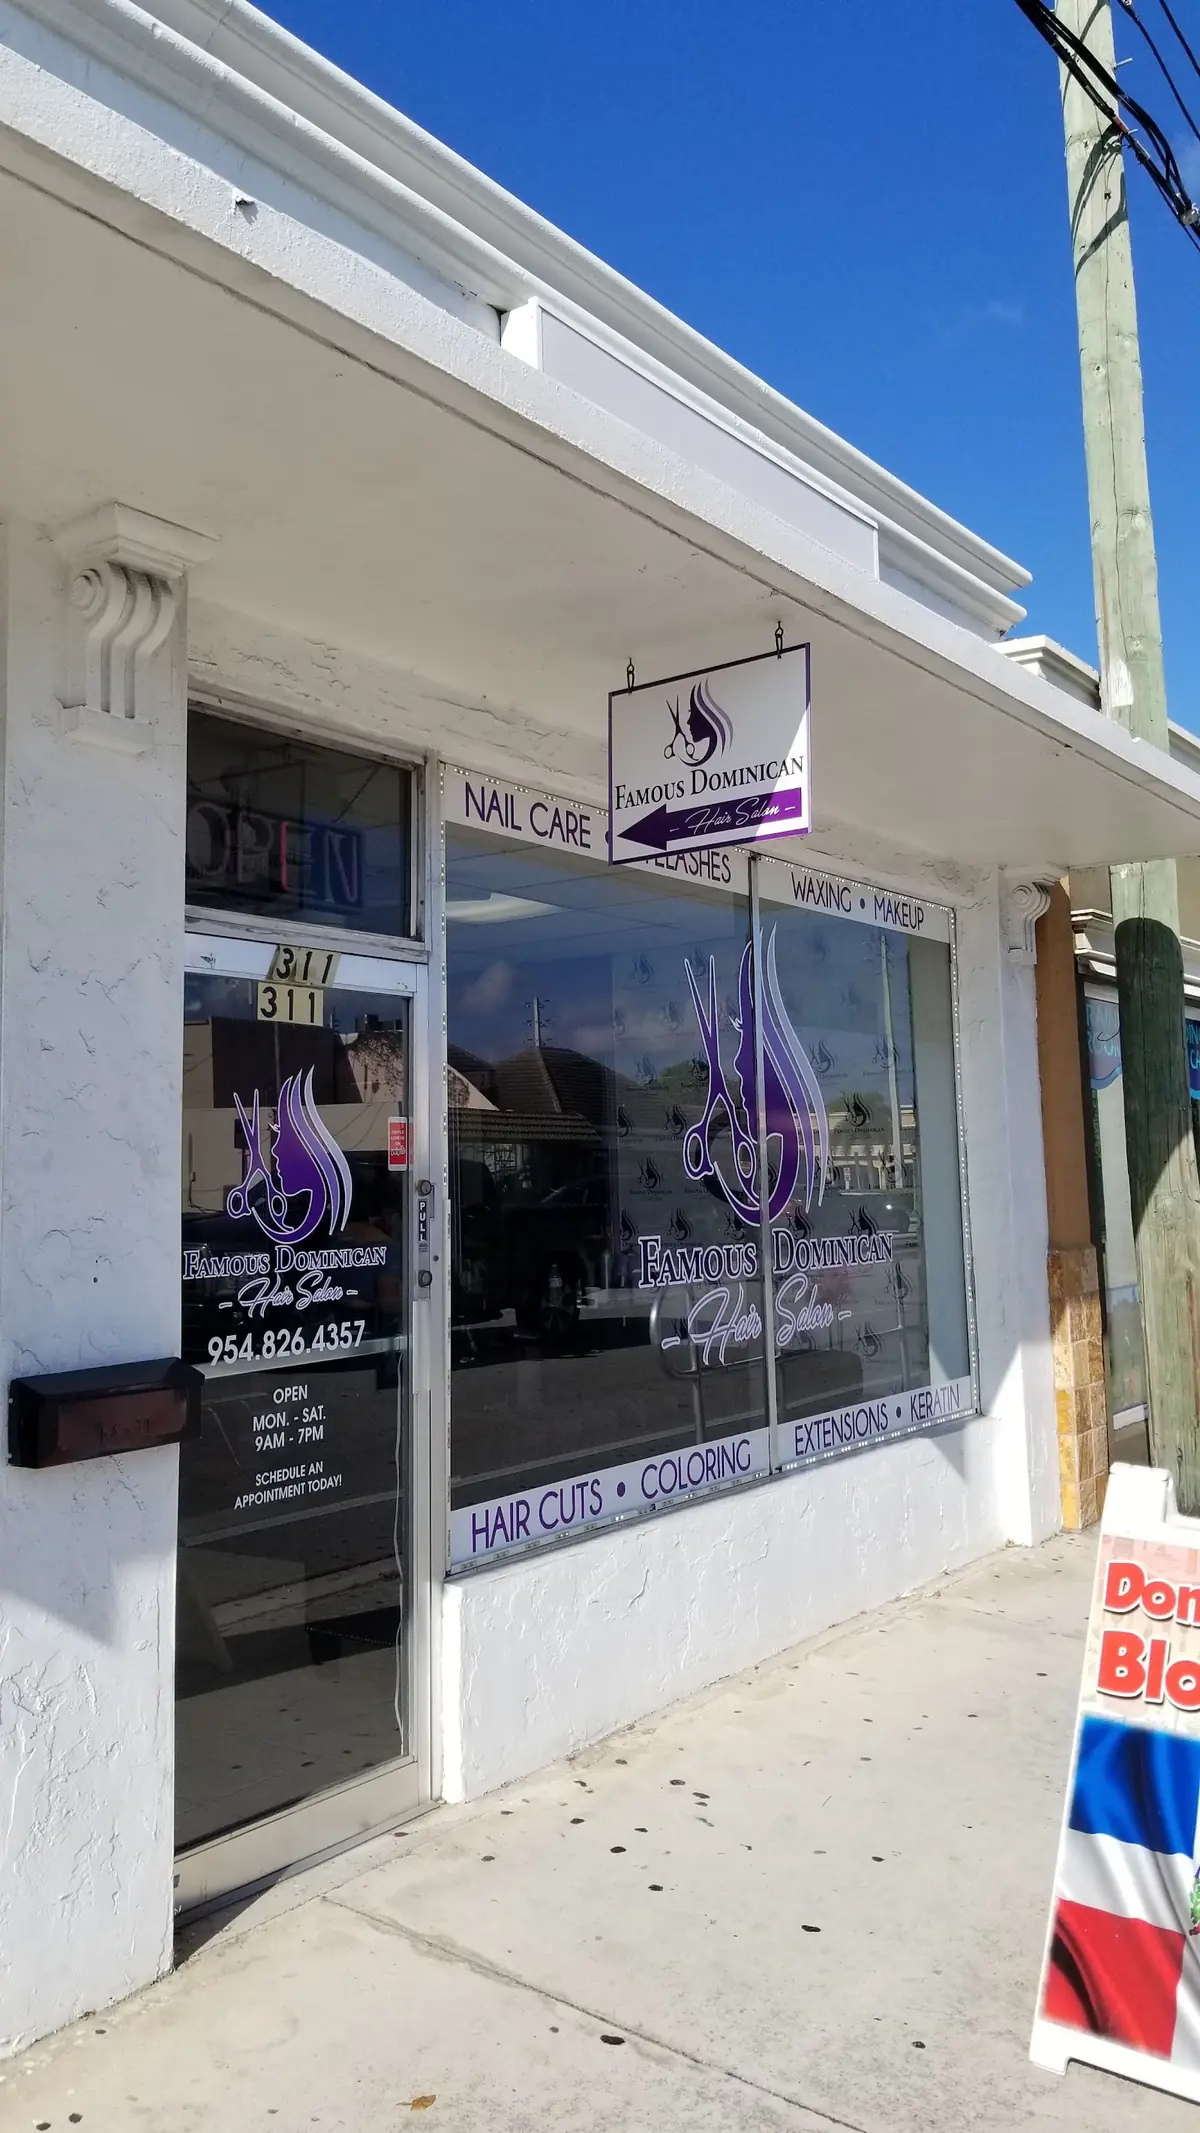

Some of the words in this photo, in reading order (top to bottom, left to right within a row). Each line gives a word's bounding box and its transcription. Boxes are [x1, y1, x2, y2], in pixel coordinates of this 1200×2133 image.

[615, 780, 685, 811] FAMOUS
[690, 756, 804, 796] DOMINICAN
[465, 781, 522, 832] NAIL
[530, 802, 591, 849] CARE
[685, 808, 732, 835] Hair
[736, 797, 780, 826] Salon
[791, 872, 852, 913] WAXING
[874, 895, 925, 931] MAKEUP
[276, 947, 334, 985] 311
[260, 986, 317, 1025] 311
[183, 1250, 270, 1280] FAMOUS
[275, 1245, 387, 1273] DOMINICAN
[638, 1235, 757, 1289] FAMOUS
[772, 1228, 894, 1275] DOMINICAN
[238, 1273, 294, 1318] Hair
[296, 1270, 344, 1310] Salon
[688, 1282, 762, 1365] Hair
[775, 1273, 834, 1347] Salon
[208, 1319, 366, 1367] 954.826.4357
[273, 1384, 308, 1404] OPEN
[253, 1411, 290, 1432] MON.
[302, 1405, 326, 1423] SAT.
[255, 1432, 285, 1452] 9AM
[298, 1425, 324, 1444] 7PM
[794, 1402, 889, 1457] EXTENSIONS
[910, 1384, 960, 1423] KERATIN
[234, 1482, 306, 1510] APPOINTMENT
[307, 1474, 342, 1493] TODAY!
[255, 1464, 306, 1487] SCHEDULE
[308, 1461, 324, 1476] AN
[472, 1499, 531, 1553] HAIR
[539, 1478, 603, 1530] CUTS
[641, 1439, 751, 1500] COLORING
